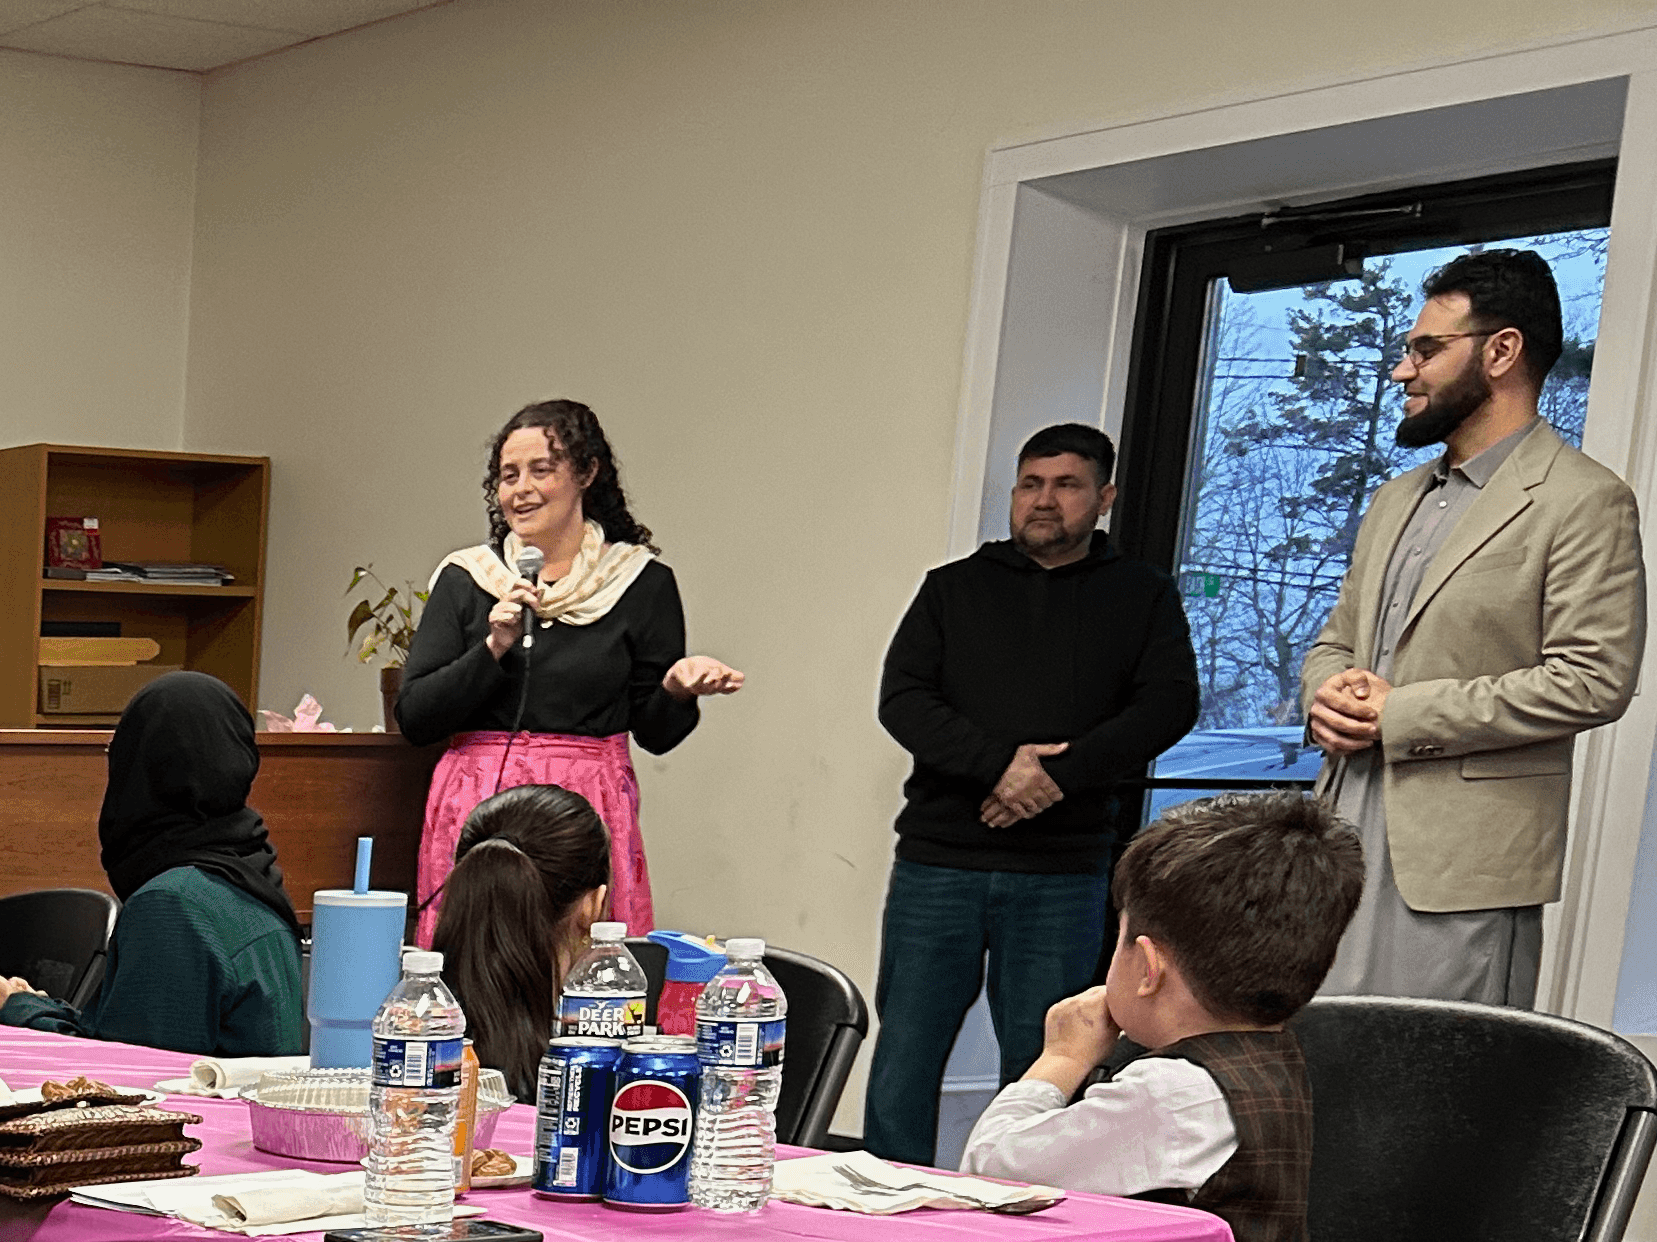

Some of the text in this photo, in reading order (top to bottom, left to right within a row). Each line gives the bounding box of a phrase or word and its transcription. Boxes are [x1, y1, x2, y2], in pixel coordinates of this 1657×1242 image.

[579, 1007, 625, 1022] DEER
[578, 1022, 626, 1037] PARK
[611, 1115, 688, 1137] PEPSI
